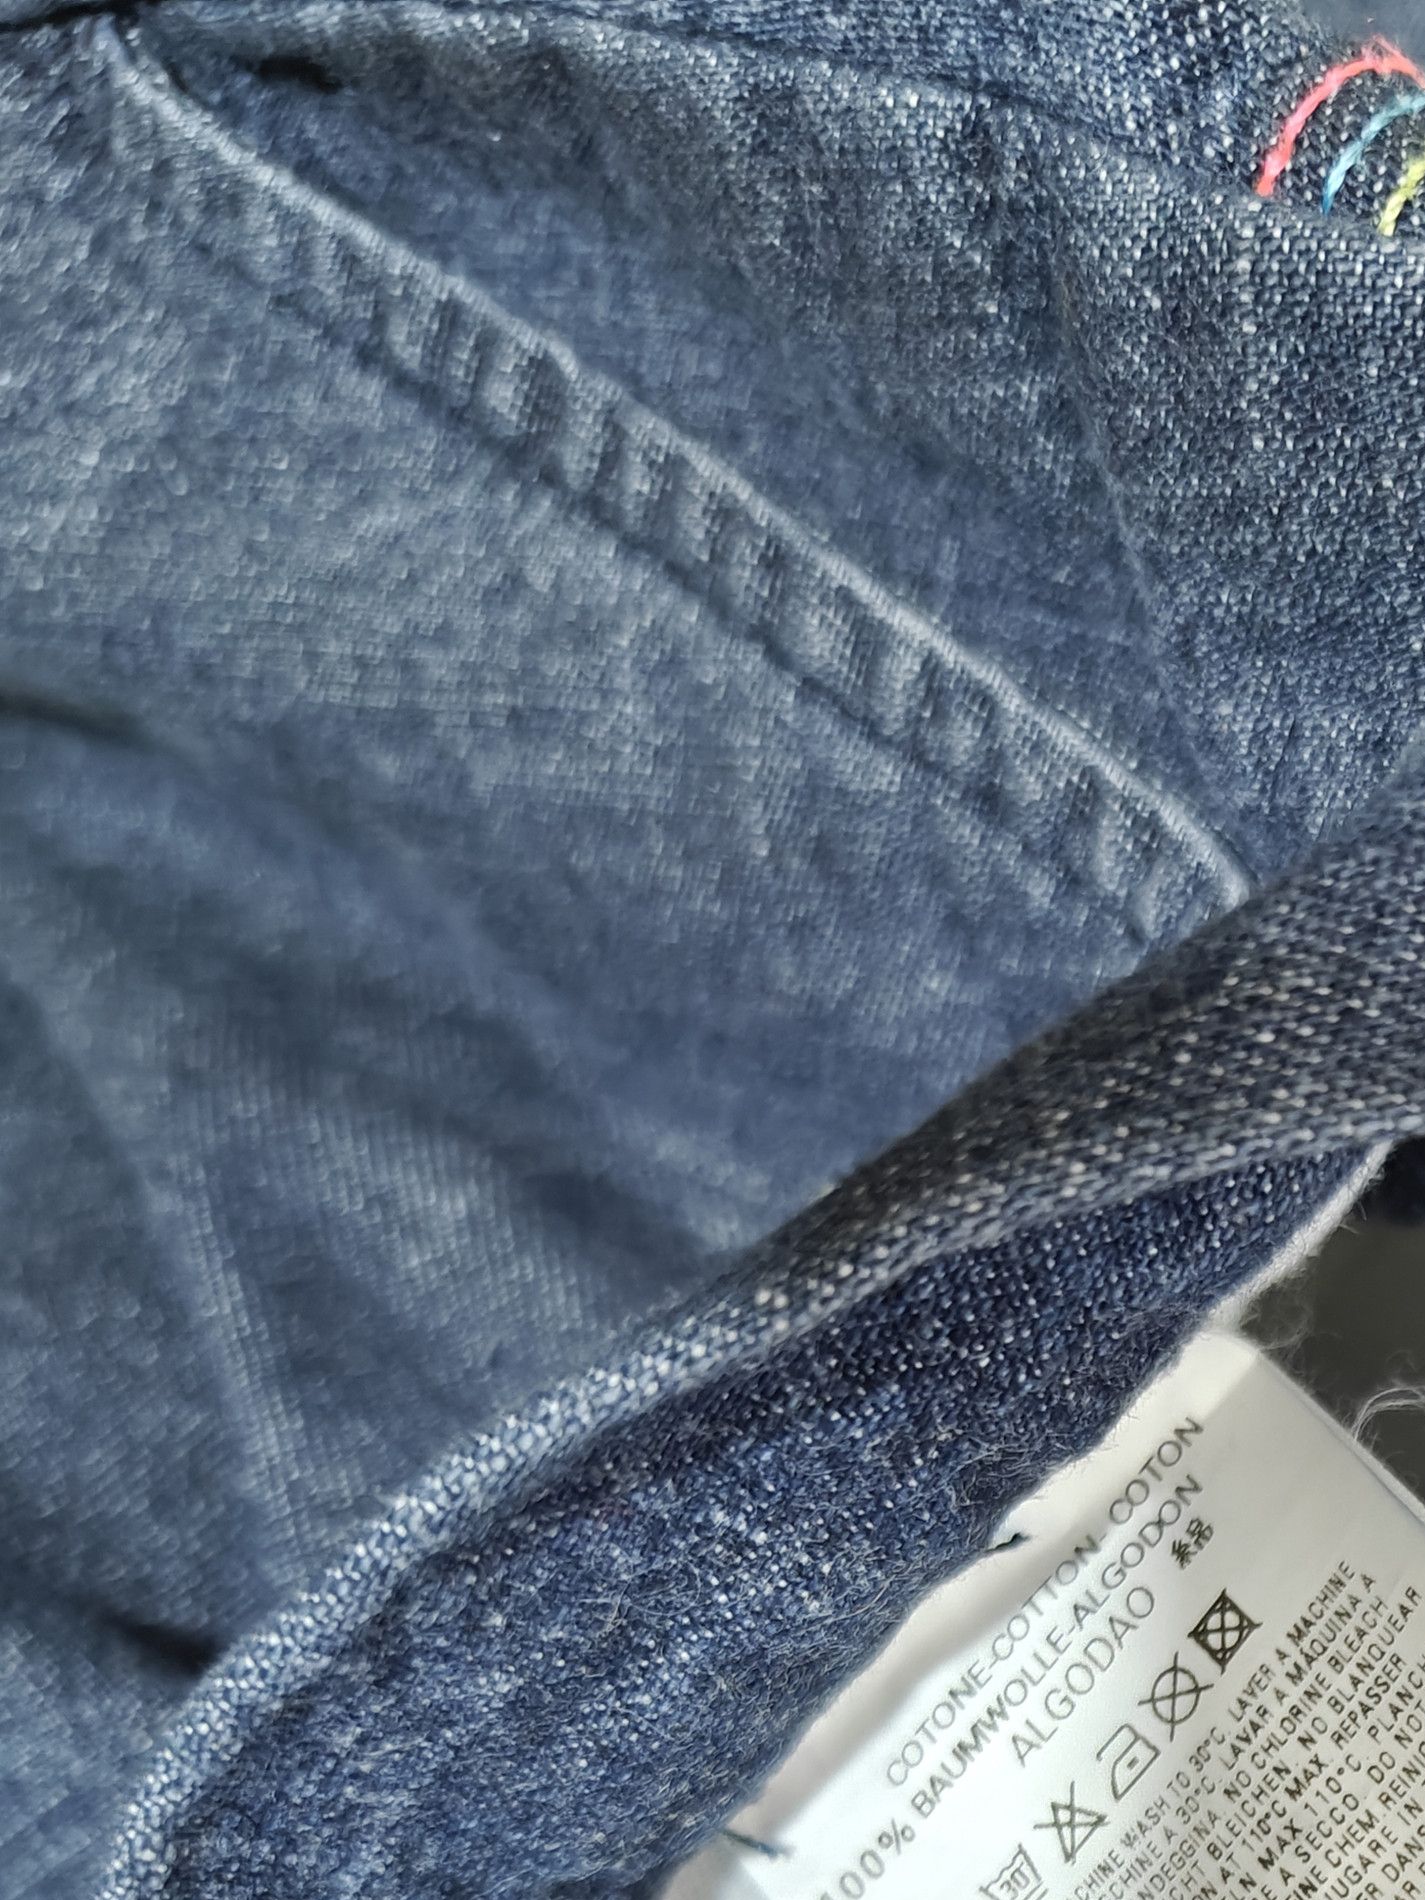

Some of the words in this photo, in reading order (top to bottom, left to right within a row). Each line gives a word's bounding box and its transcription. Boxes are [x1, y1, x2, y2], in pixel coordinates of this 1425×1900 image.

[1106, 1416, 1204, 1524] COTON
[910, 1473, 1203, 1818] BAUMWOLLE-ALGODON
[1010, 1585, 1155, 1768] ALGODAO
[1118, 1795, 1171, 1850] WASH
[1165, 1769, 1192, 1797] TO
[1226, 1663, 1275, 1722] LAVER
[1284, 1559, 1356, 1647] MACHINE
[1221, 1769, 1253, 1804] NO
[1249, 1671, 1332, 1771] CHLORINE
[1326, 1595, 1389, 1674] BLEACH
[1295, 1715, 1329, 1751] NO
[1325, 1585, 1422, 1715] BLANQUEAR
[1216, 1851, 1241, 1884] AT
[1328, 1652, 1407, 1750] REPASSER
[1218, 1703, 1272, 1771] LAVAR
[1365, 1749, 1397, 1784] DO
[1256, 1817, 1304, 1871] MAX
[1395, 1797, 1424, 1826] IN
[999, 1865, 1029, 1900] 30
